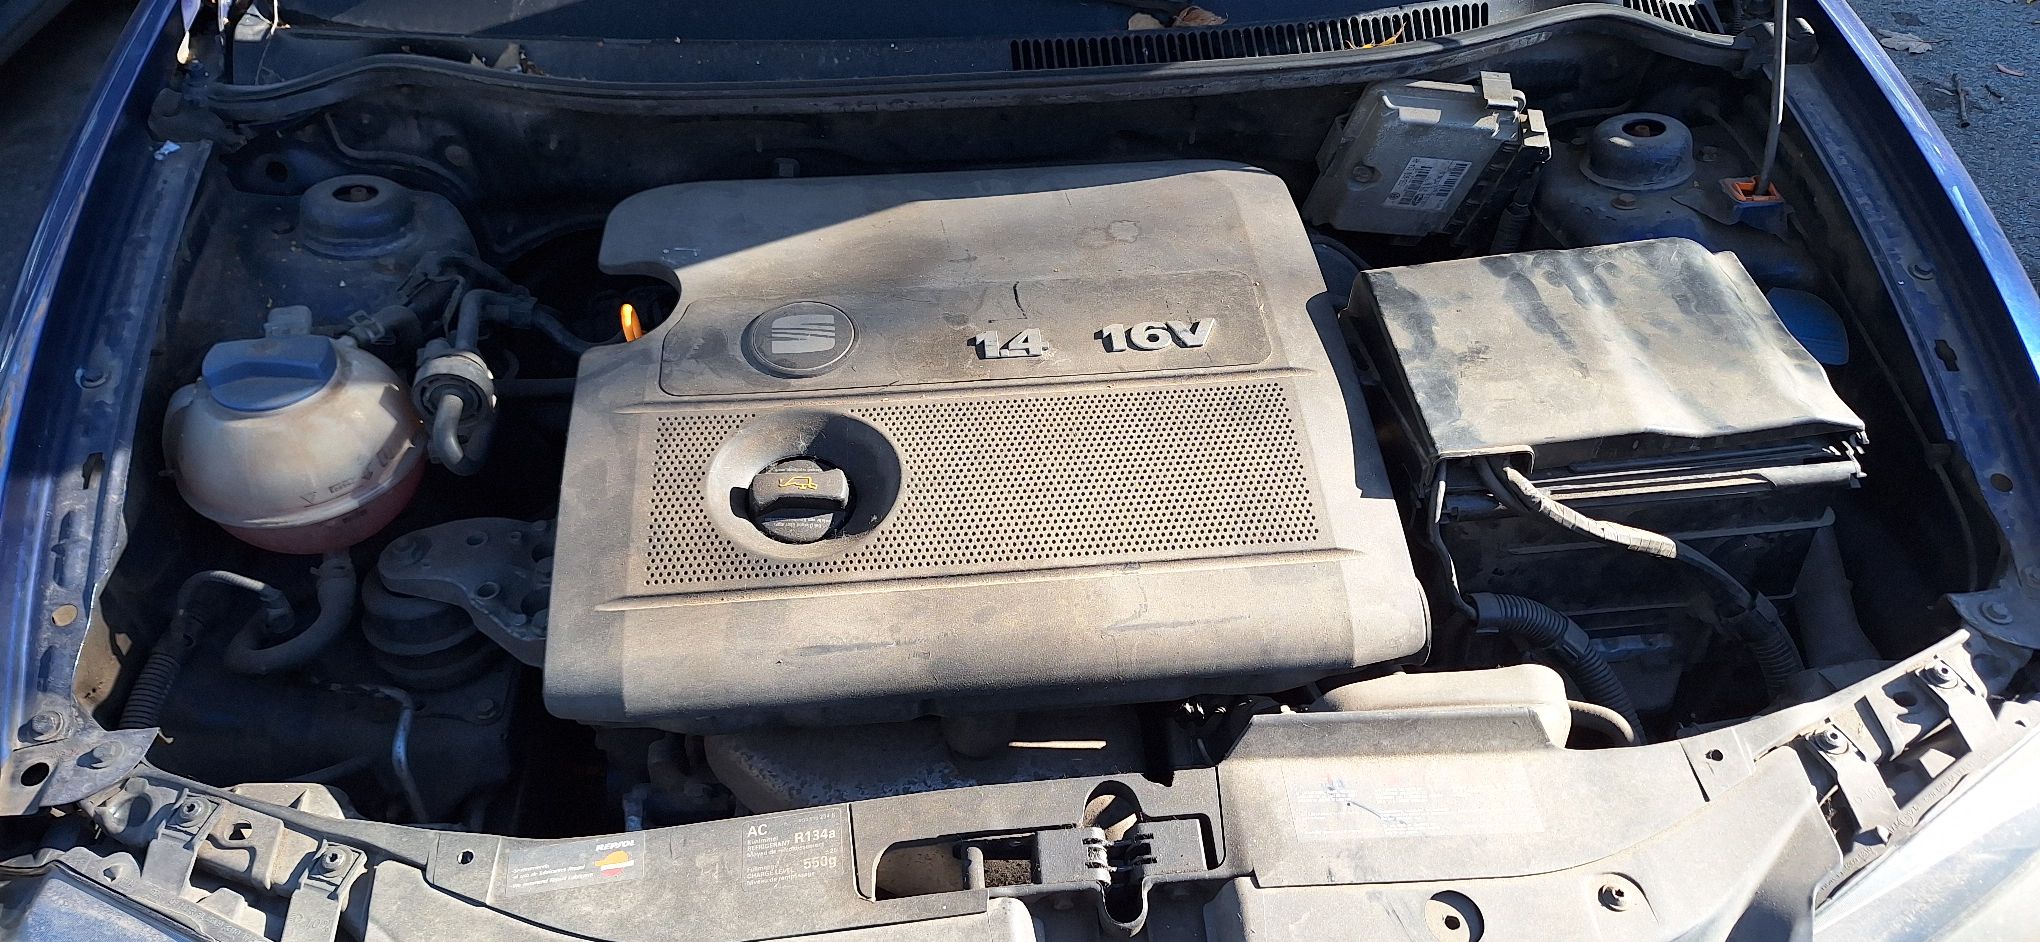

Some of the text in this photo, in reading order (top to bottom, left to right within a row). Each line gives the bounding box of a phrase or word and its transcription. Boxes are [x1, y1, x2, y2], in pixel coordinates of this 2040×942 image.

[1098, 318, 1216, 353] 16V
[747, 823, 768, 838] AC
[794, 828, 836, 844] R134a
[595, 839, 635, 851] REPSOL
[803, 855, 837, 869] 550g
